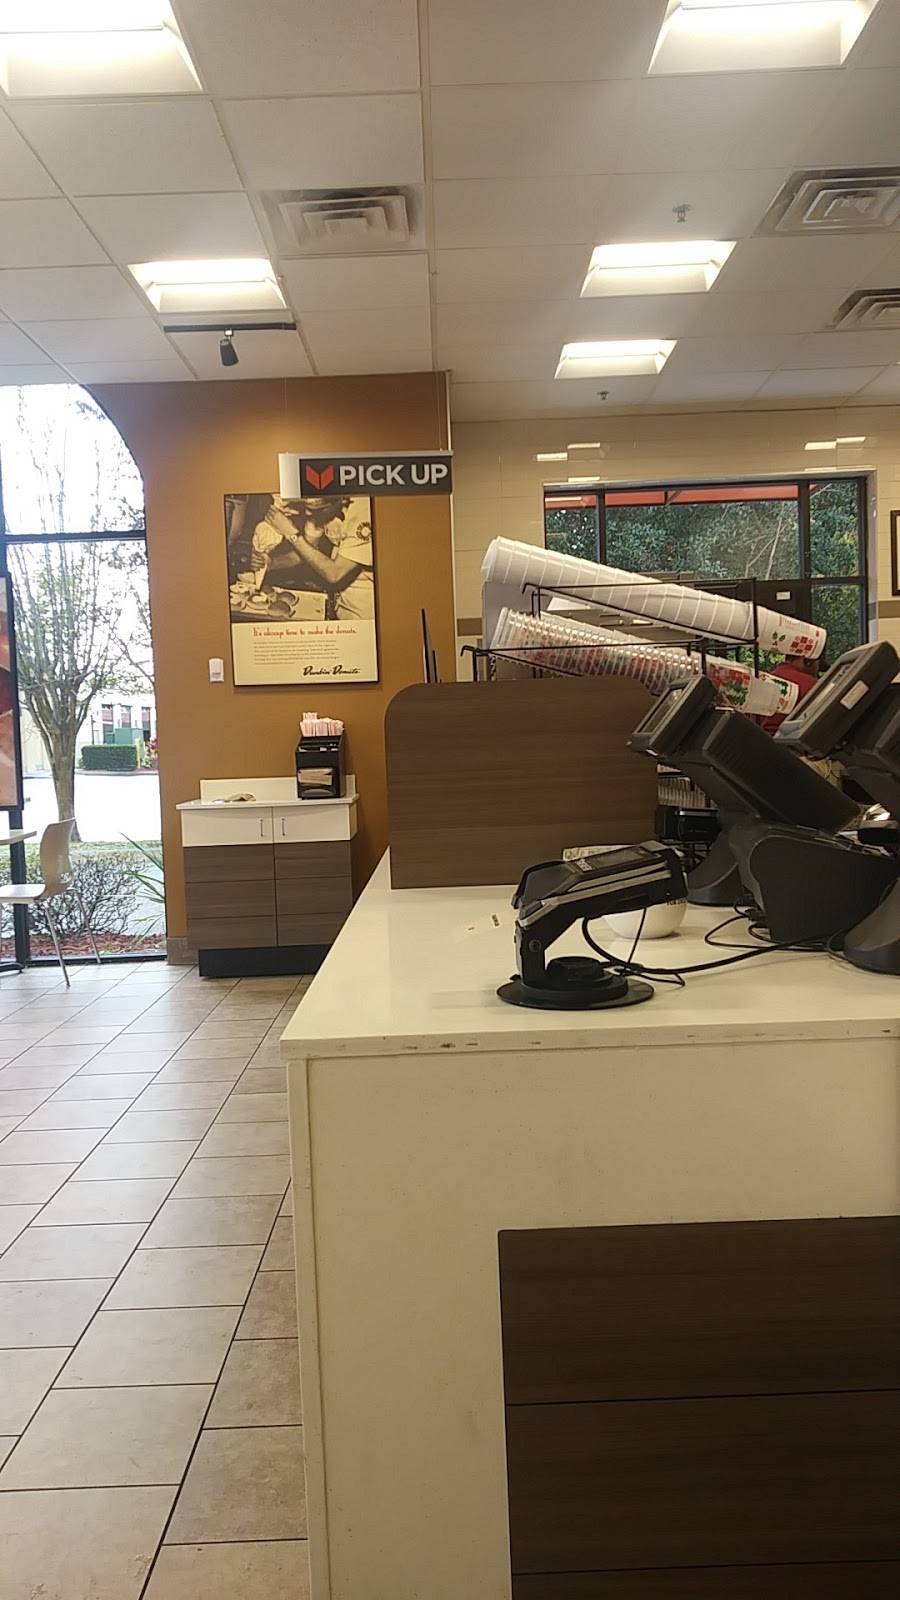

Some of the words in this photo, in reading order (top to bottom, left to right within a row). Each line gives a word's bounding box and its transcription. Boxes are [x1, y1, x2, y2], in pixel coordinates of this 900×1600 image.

[339, 464, 406, 486] PICK
[411, 463, 448, 485] UP
[299, 627, 305, 635] to
[325, 625, 334, 635] the
[332, 664, 361, 676] Donuts
